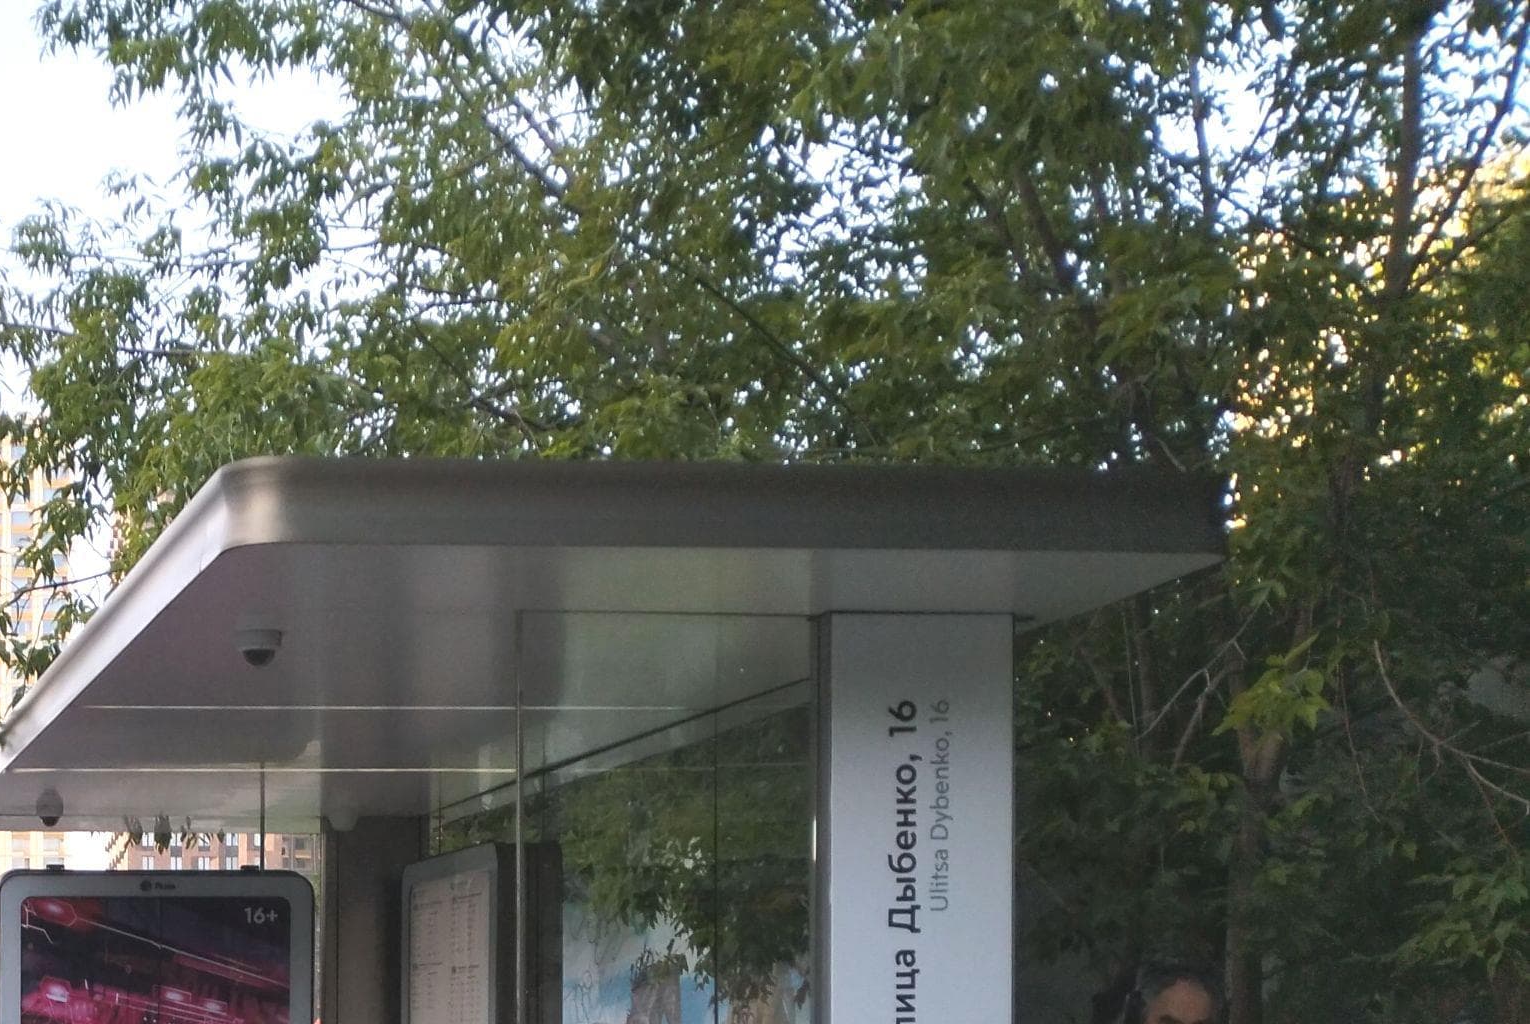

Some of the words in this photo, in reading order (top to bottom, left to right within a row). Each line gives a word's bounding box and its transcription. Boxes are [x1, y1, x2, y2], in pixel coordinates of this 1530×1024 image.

[889, 700, 917, 738] 16
[929, 700, 950, 724] 16
[929, 731, 953, 841] Dybenko,
[888, 754, 922, 933] Дыбенко,
[929, 849, 950, 912] Ulitsa
[244, 907, 278, 923] 16+
